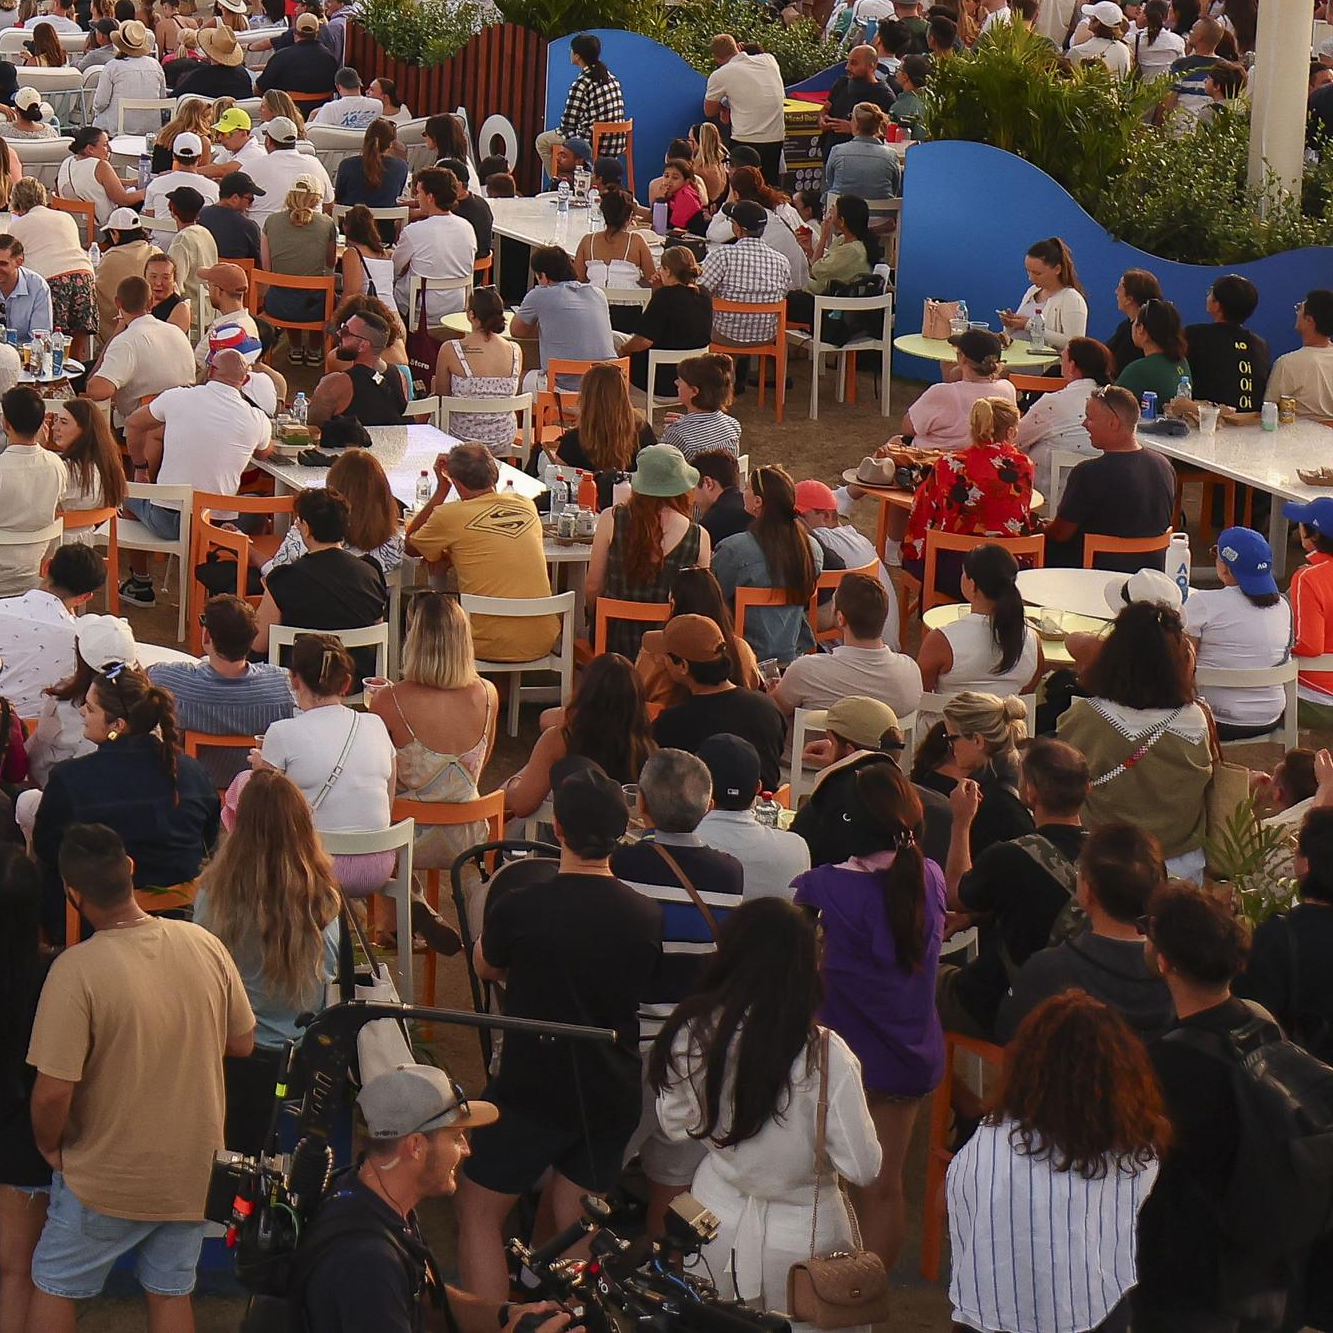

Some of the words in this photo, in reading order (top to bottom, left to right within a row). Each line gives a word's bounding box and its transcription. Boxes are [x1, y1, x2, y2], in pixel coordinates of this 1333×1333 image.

[1238, 361, 1252, 374] Oi
[1240, 378, 1252, 392] Oi
[1239, 395, 1252, 409] Oi
[1257, 562, 1268, 571] AO
